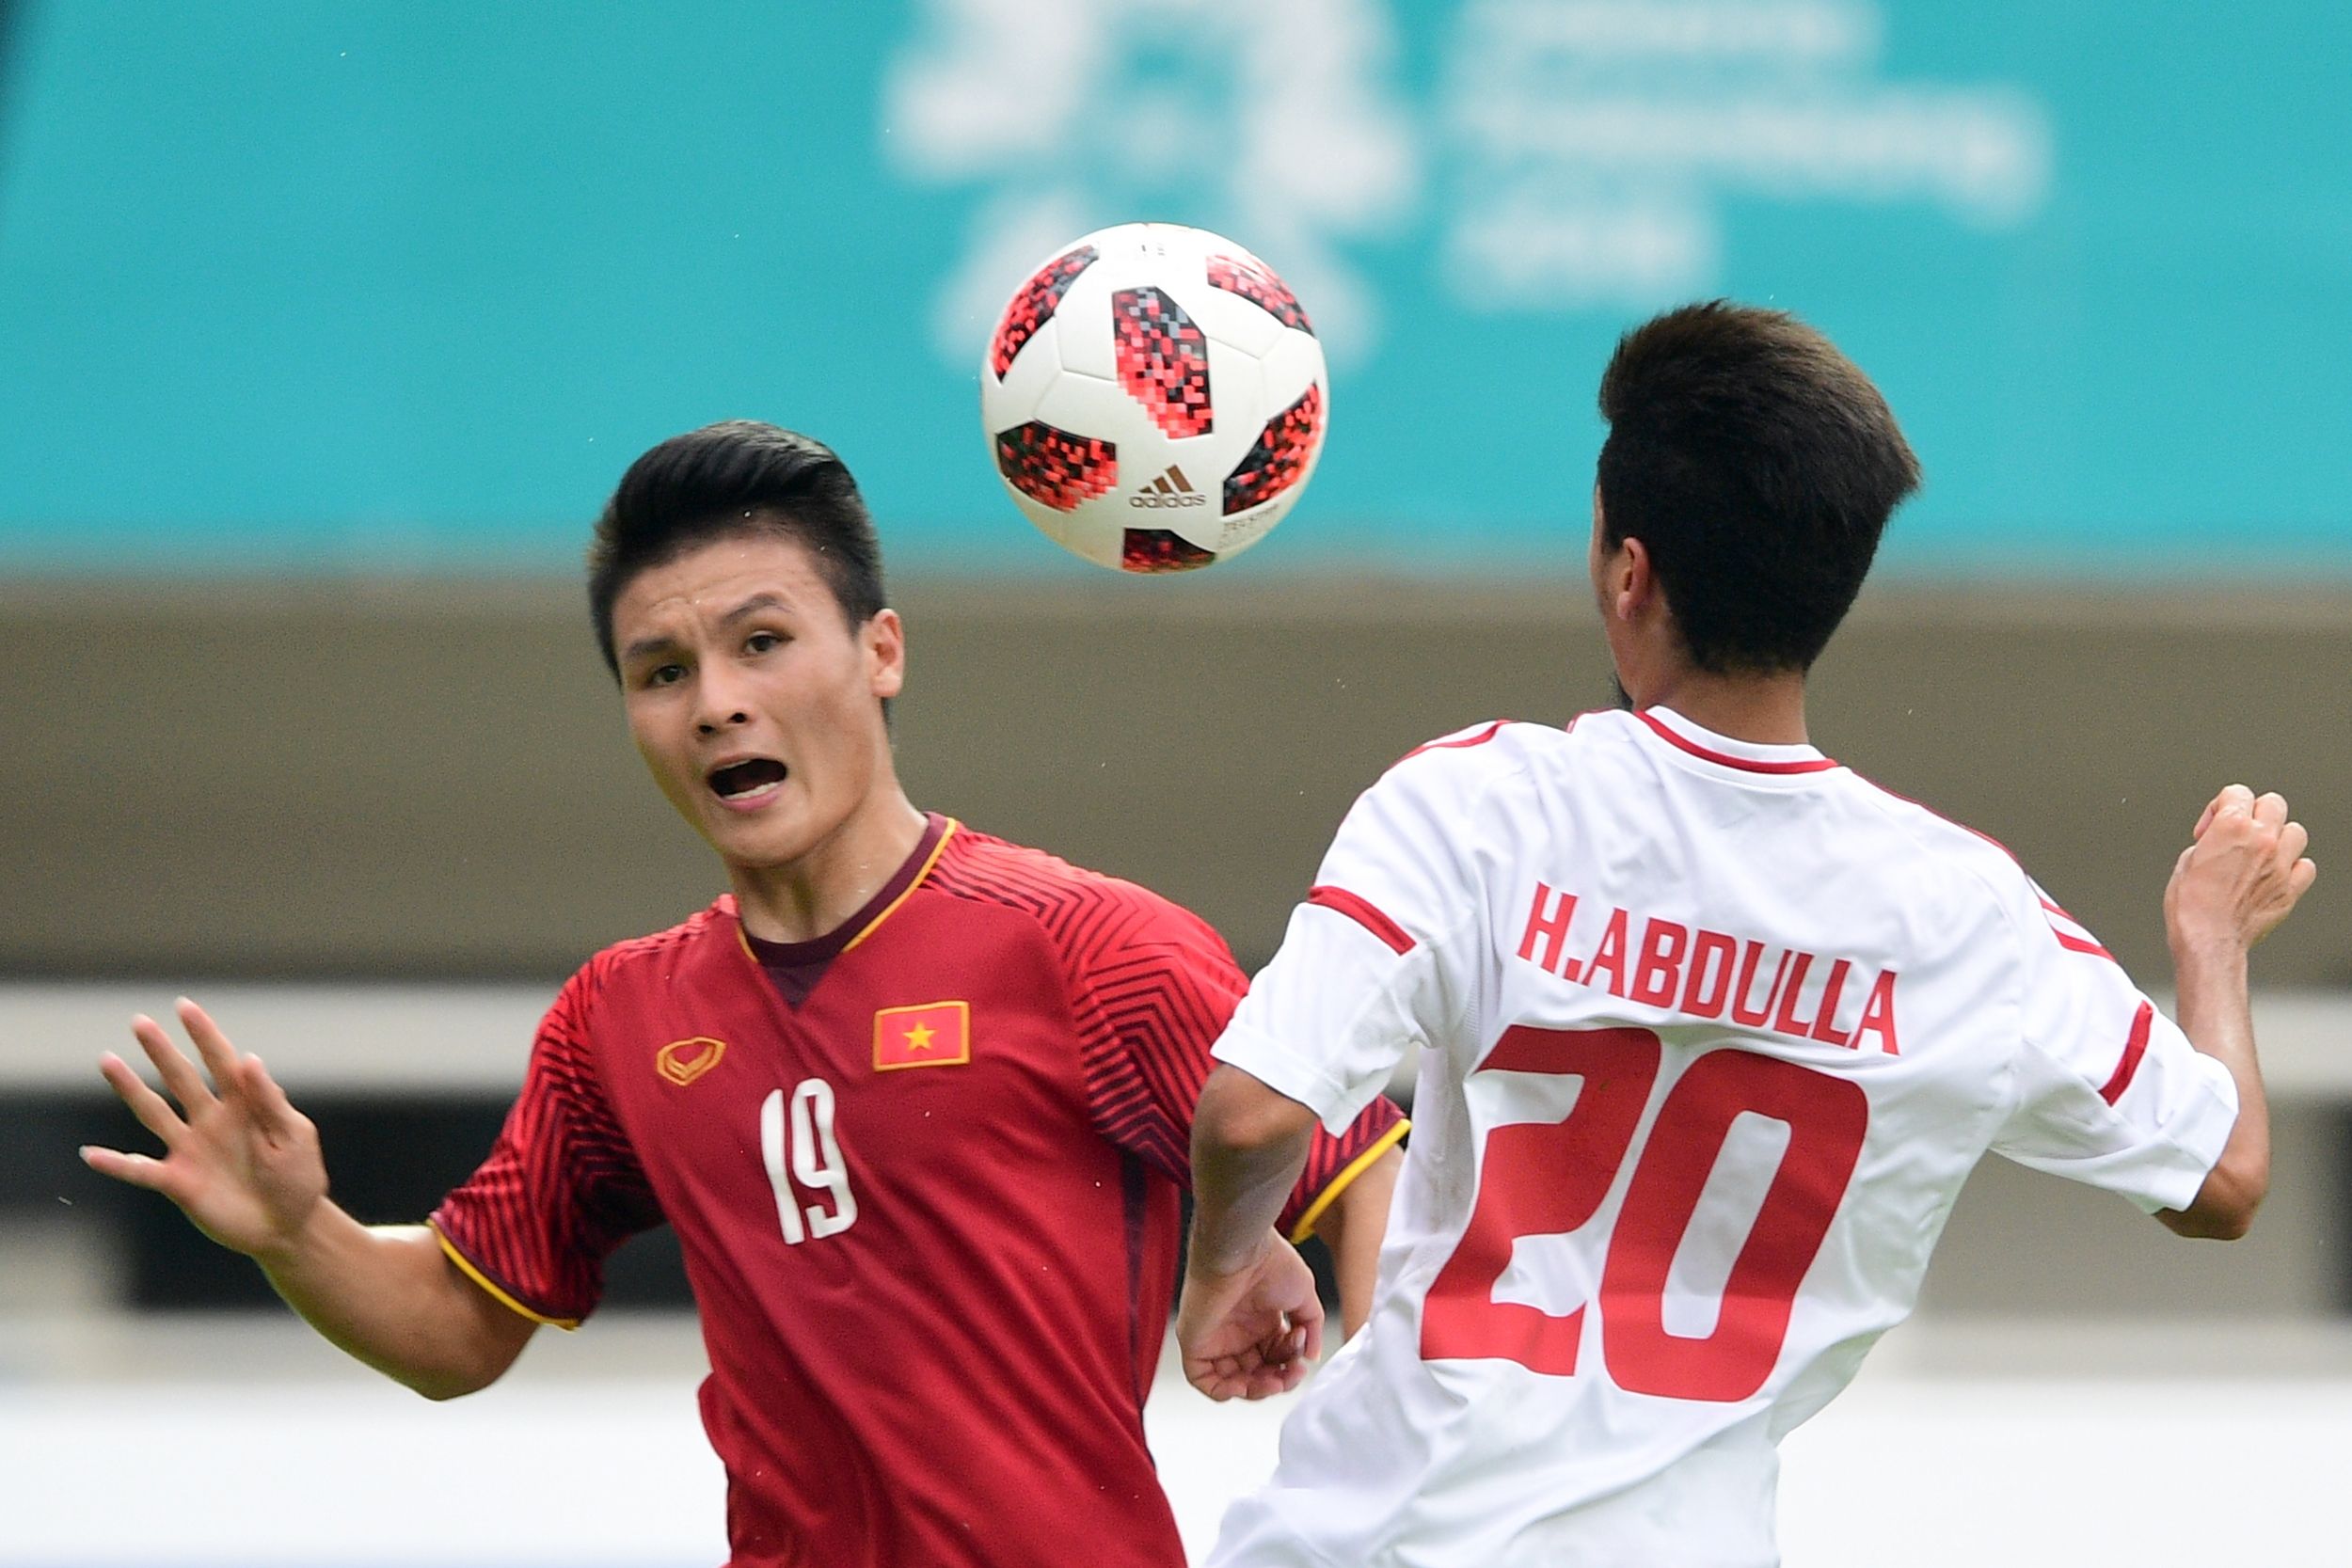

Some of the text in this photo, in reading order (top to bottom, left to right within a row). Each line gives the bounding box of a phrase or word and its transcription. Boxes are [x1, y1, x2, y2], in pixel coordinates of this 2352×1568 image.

[1129, 494, 1206, 509] adidas
[1517, 880, 1899, 1056] H.ABDULLA
[760, 1077, 858, 1245] 19
[1420, 1023, 1869, 1403] 20
